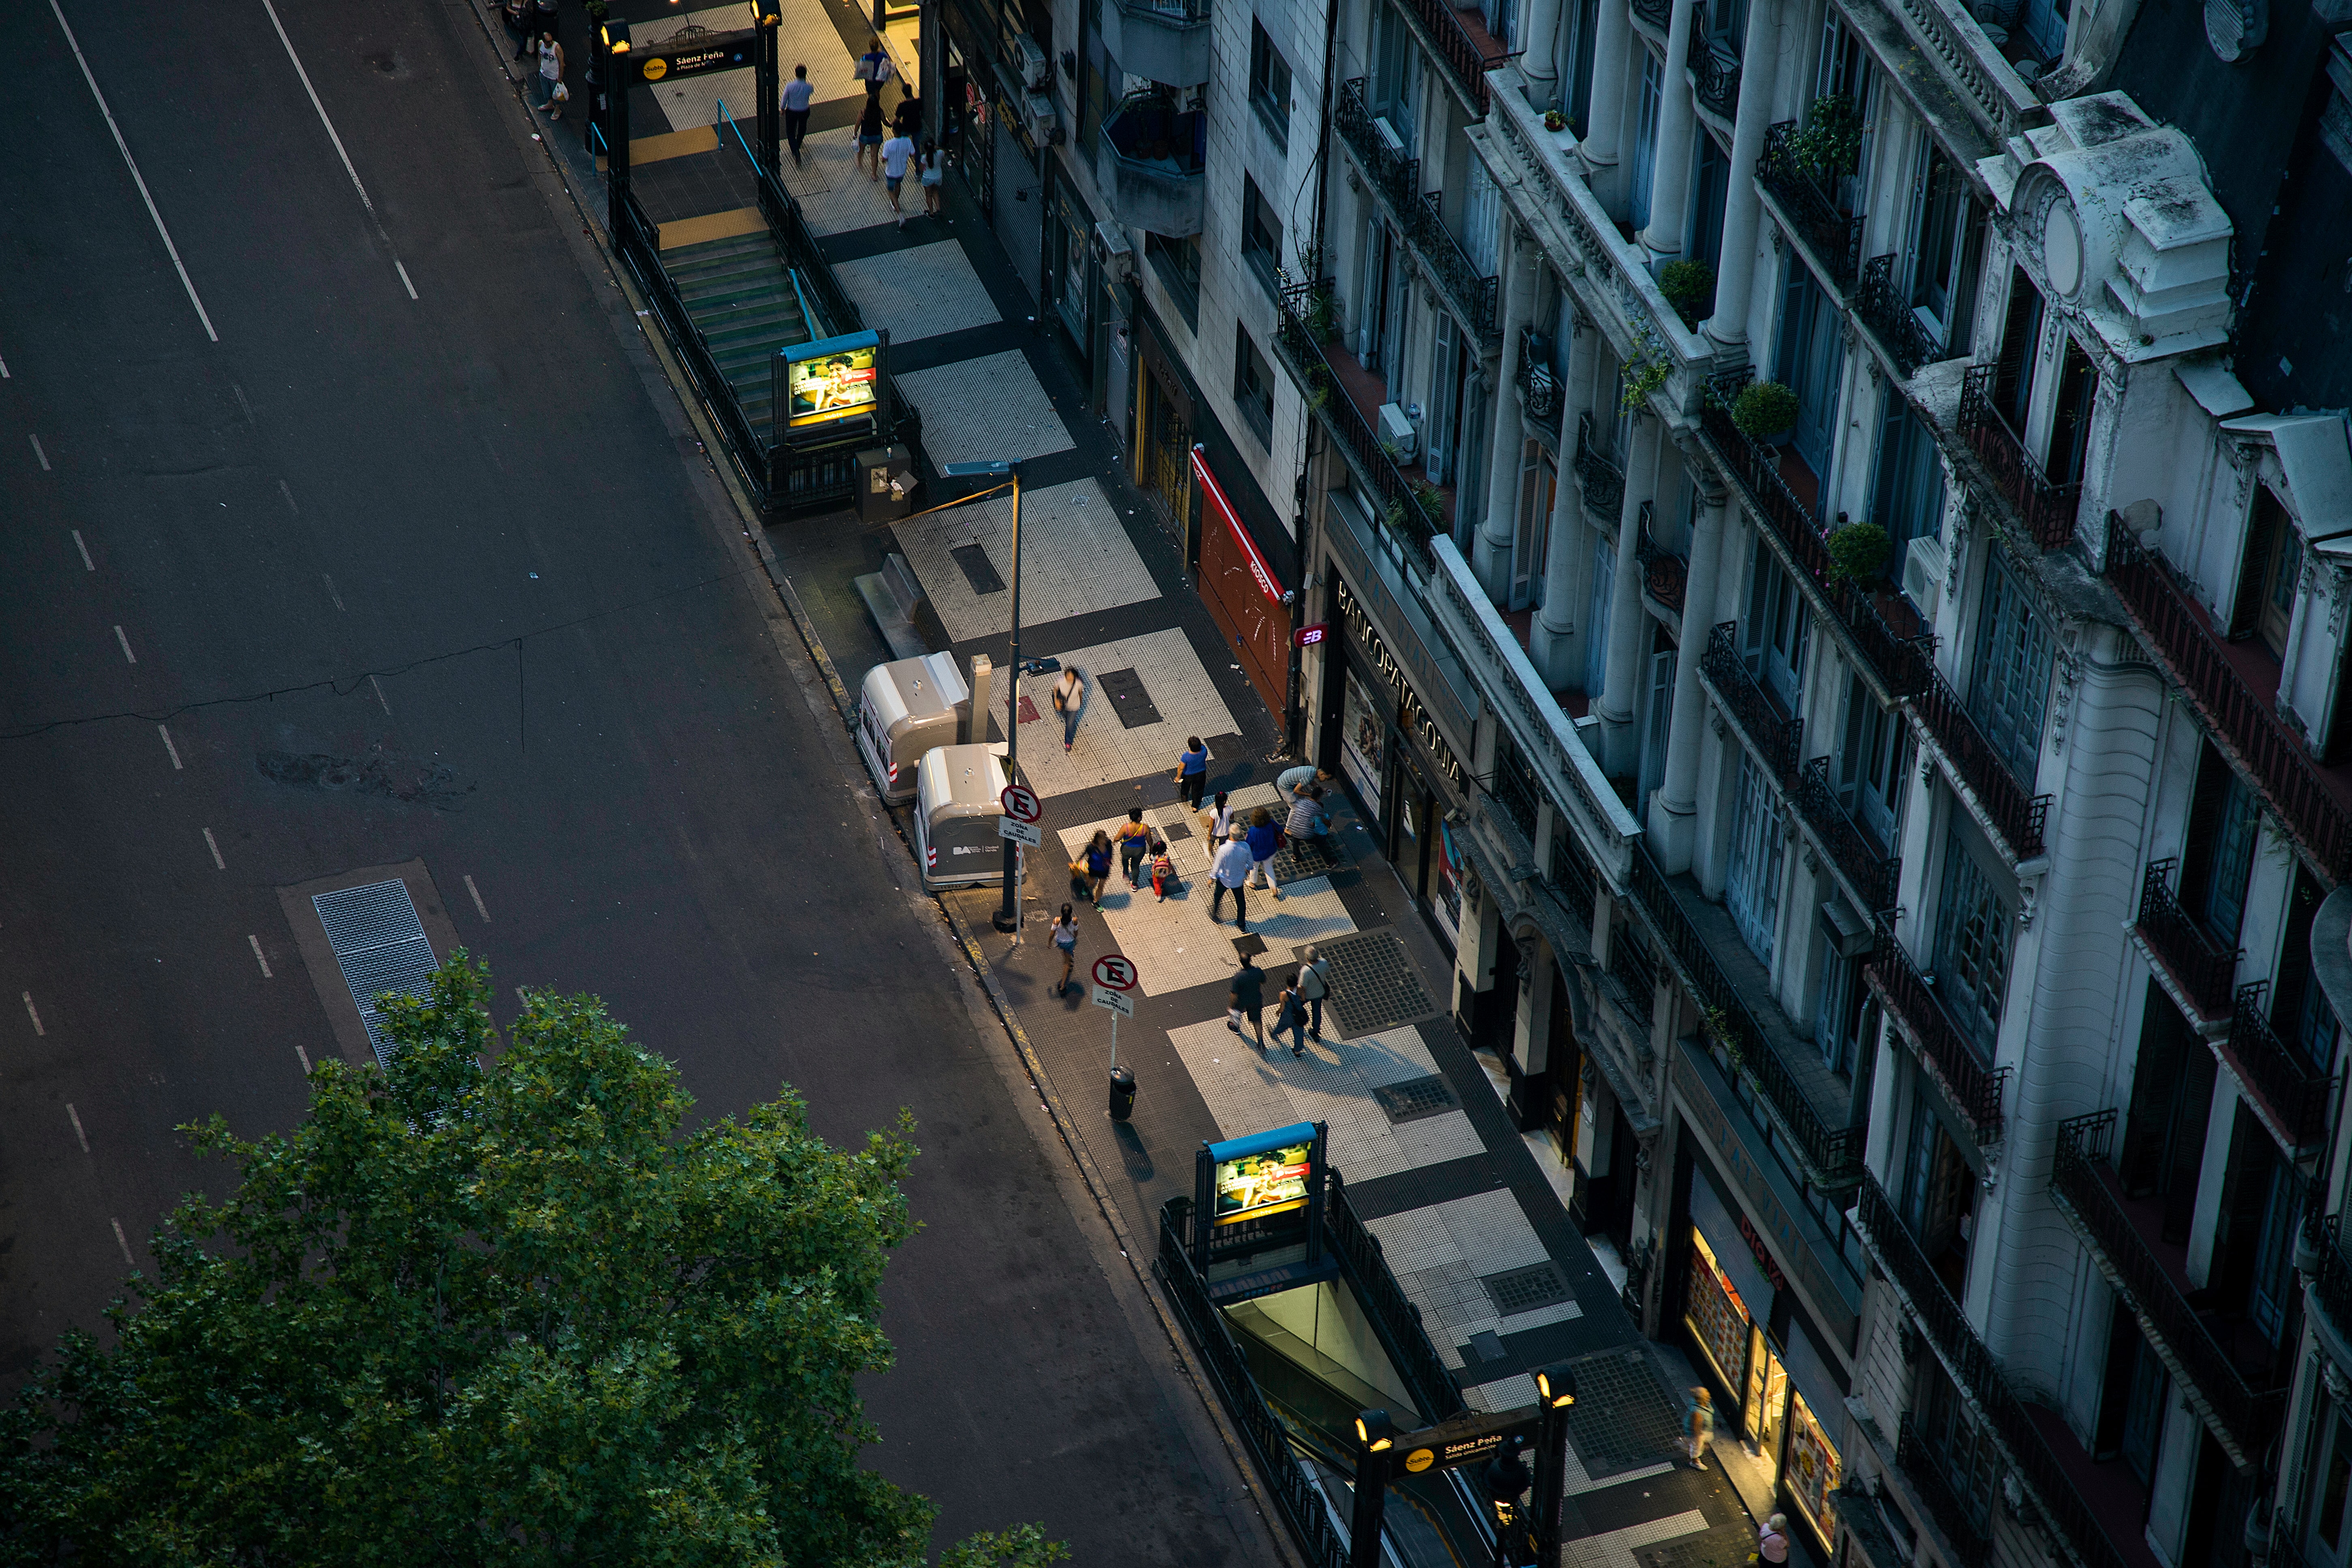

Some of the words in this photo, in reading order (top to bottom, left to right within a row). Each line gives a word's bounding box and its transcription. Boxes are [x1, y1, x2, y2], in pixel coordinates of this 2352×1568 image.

[676, 55, 701, 65] Sáenz
[1251, 560, 1269, 593] KIOSCO
[1011, 822, 1028, 831] ZONA
[1004, 830, 1036, 843] CAUDALES
[1105, 990, 1122, 1000] ZONA
[1097, 999, 1129, 1014] CAUDALES
[1252, 1209, 1273, 1217] Subte
[1445, 1442, 1475, 1454] Sáenz
[1477, 1435, 1502, 1446] Peña
[1409, 1456, 1430, 1464] Subte
